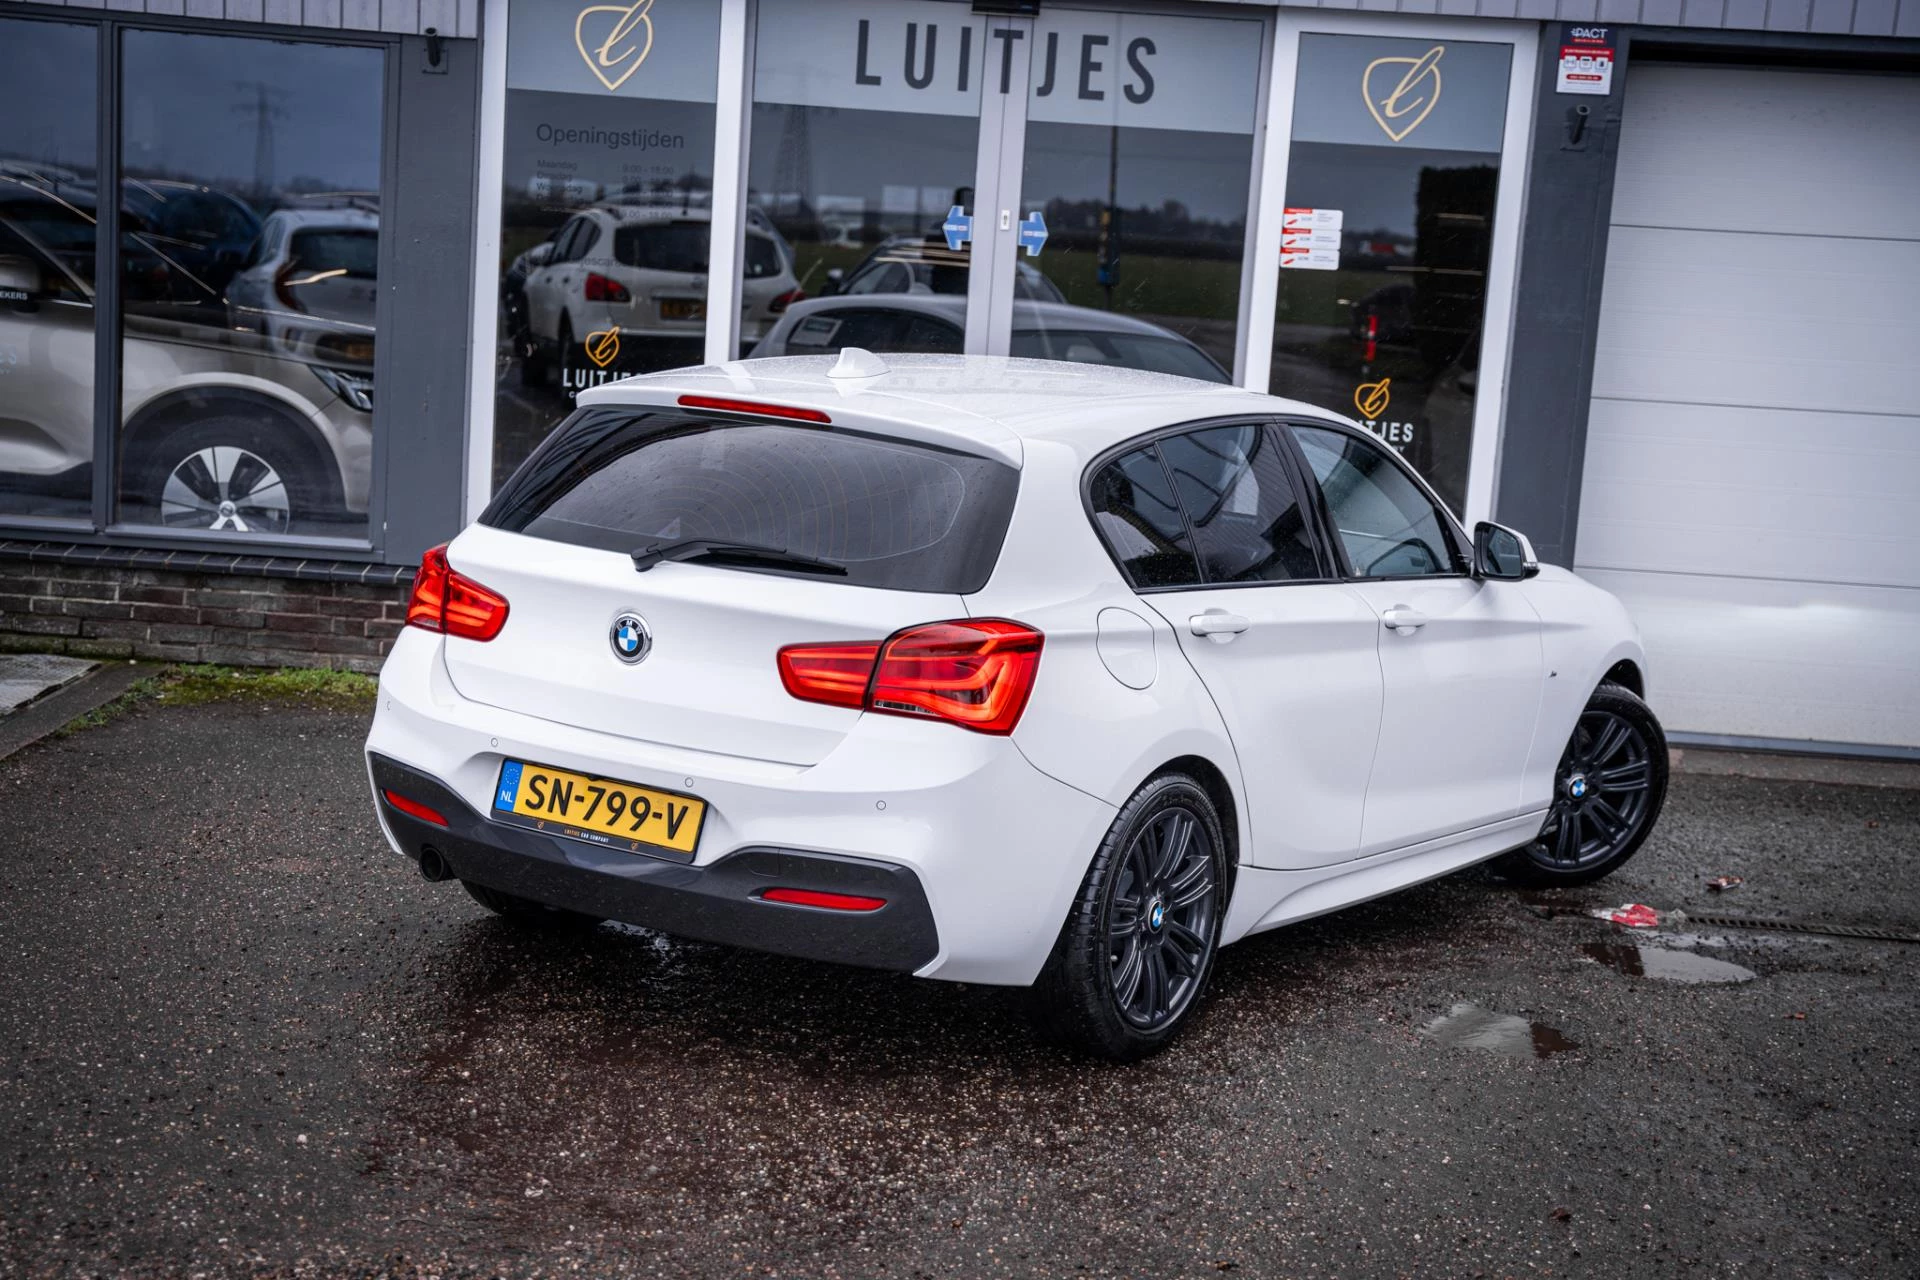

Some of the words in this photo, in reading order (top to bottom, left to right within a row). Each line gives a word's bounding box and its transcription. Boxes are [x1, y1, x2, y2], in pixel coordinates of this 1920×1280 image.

[856, 19, 1157, 104] LUITJES
[536, 123, 685, 151] Openingstijden
[500, 789, 514, 804] NL
[525, 774, 689, 840] SN-799-V
